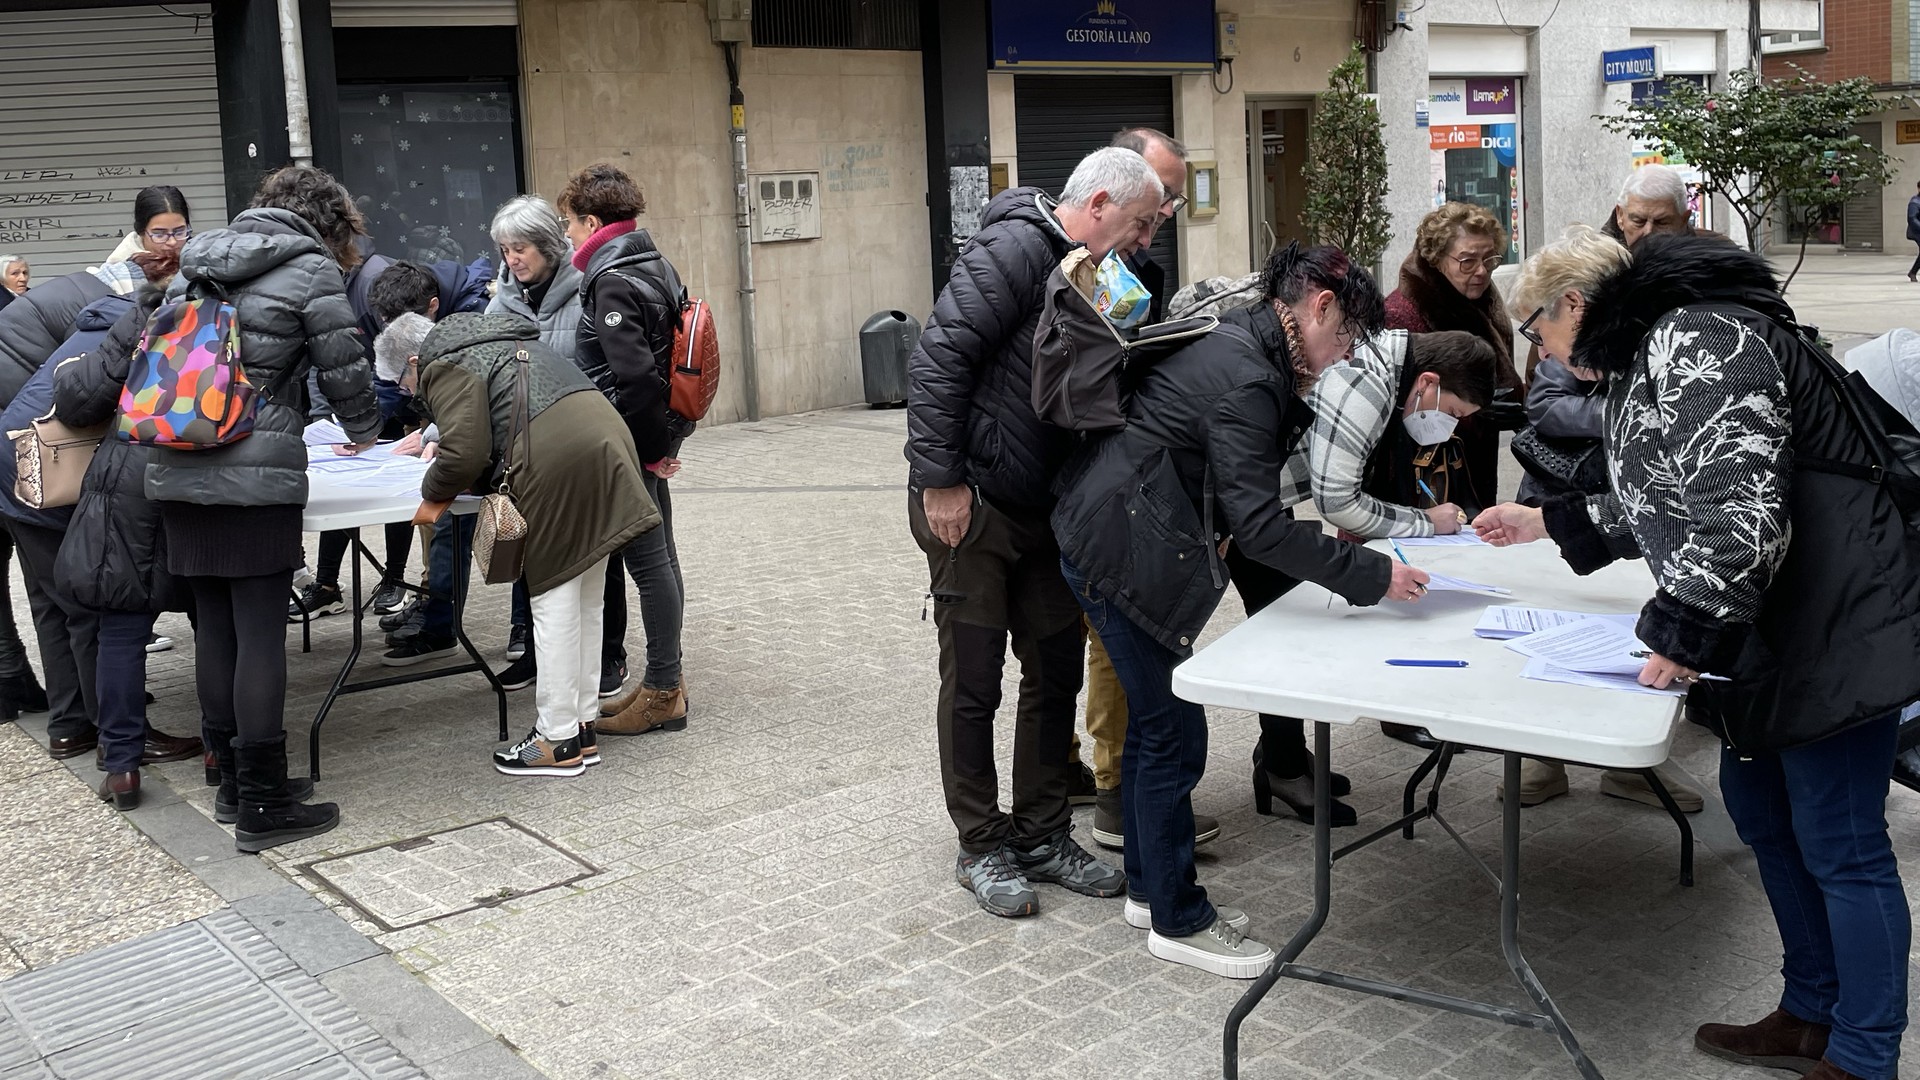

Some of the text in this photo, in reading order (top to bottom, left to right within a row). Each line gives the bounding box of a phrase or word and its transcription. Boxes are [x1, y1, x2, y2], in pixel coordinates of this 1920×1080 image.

[1066, 28, 1151, 44] GESTORÍA LLANO
[1293, 46, 1301, 62] 6
[1449, 126, 1465, 143] ria
[1481, 136, 1512, 148] DIGI
